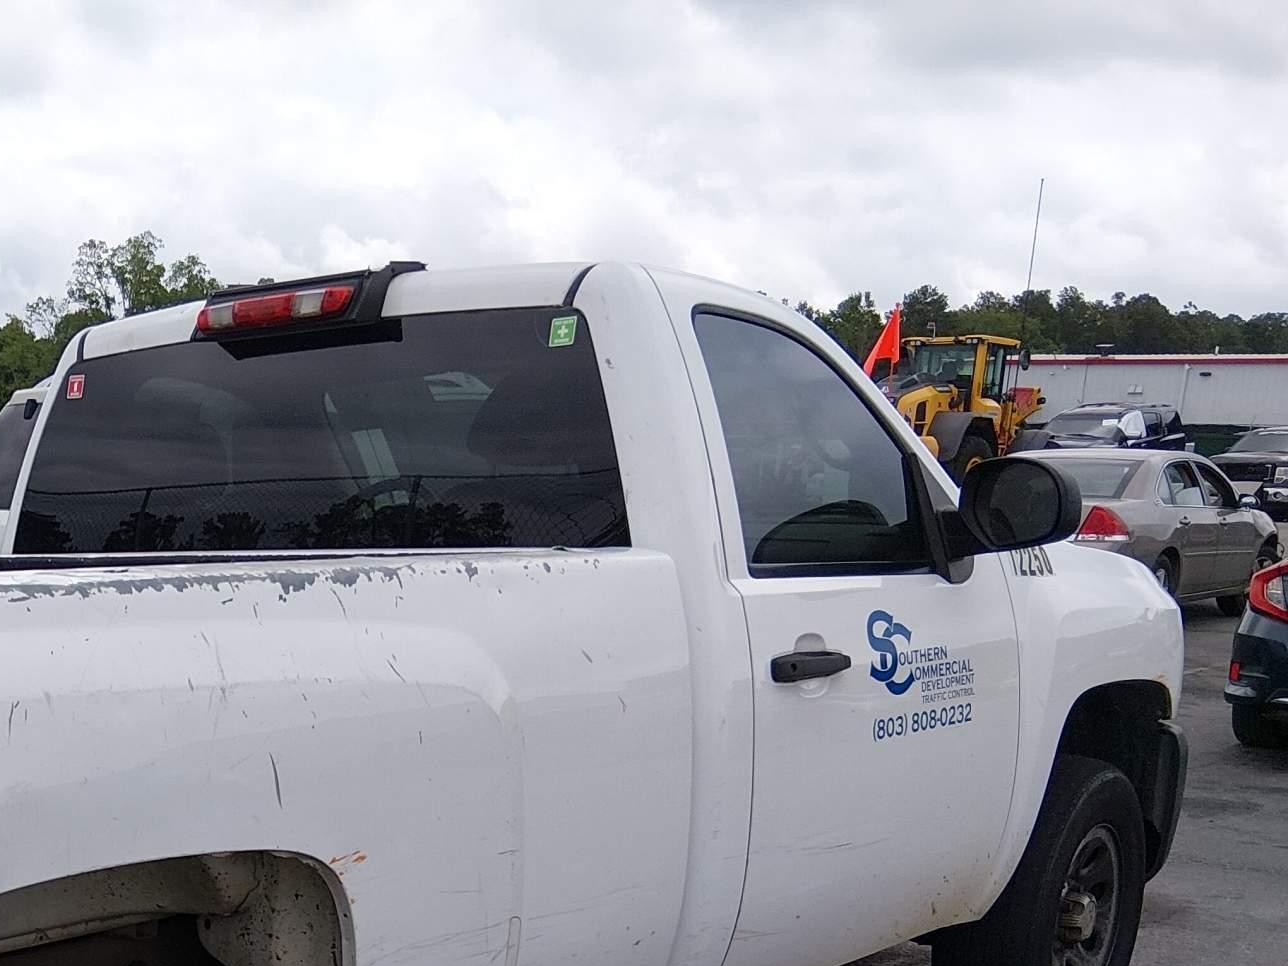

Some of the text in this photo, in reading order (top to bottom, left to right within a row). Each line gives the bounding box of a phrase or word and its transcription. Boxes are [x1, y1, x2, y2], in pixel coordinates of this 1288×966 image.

[921, 673, 975, 693] DEVELOPMENT
[921, 688, 975, 704] TRAFFIC CONTROL
[872, 703, 972, 742] (803) 808-0232
